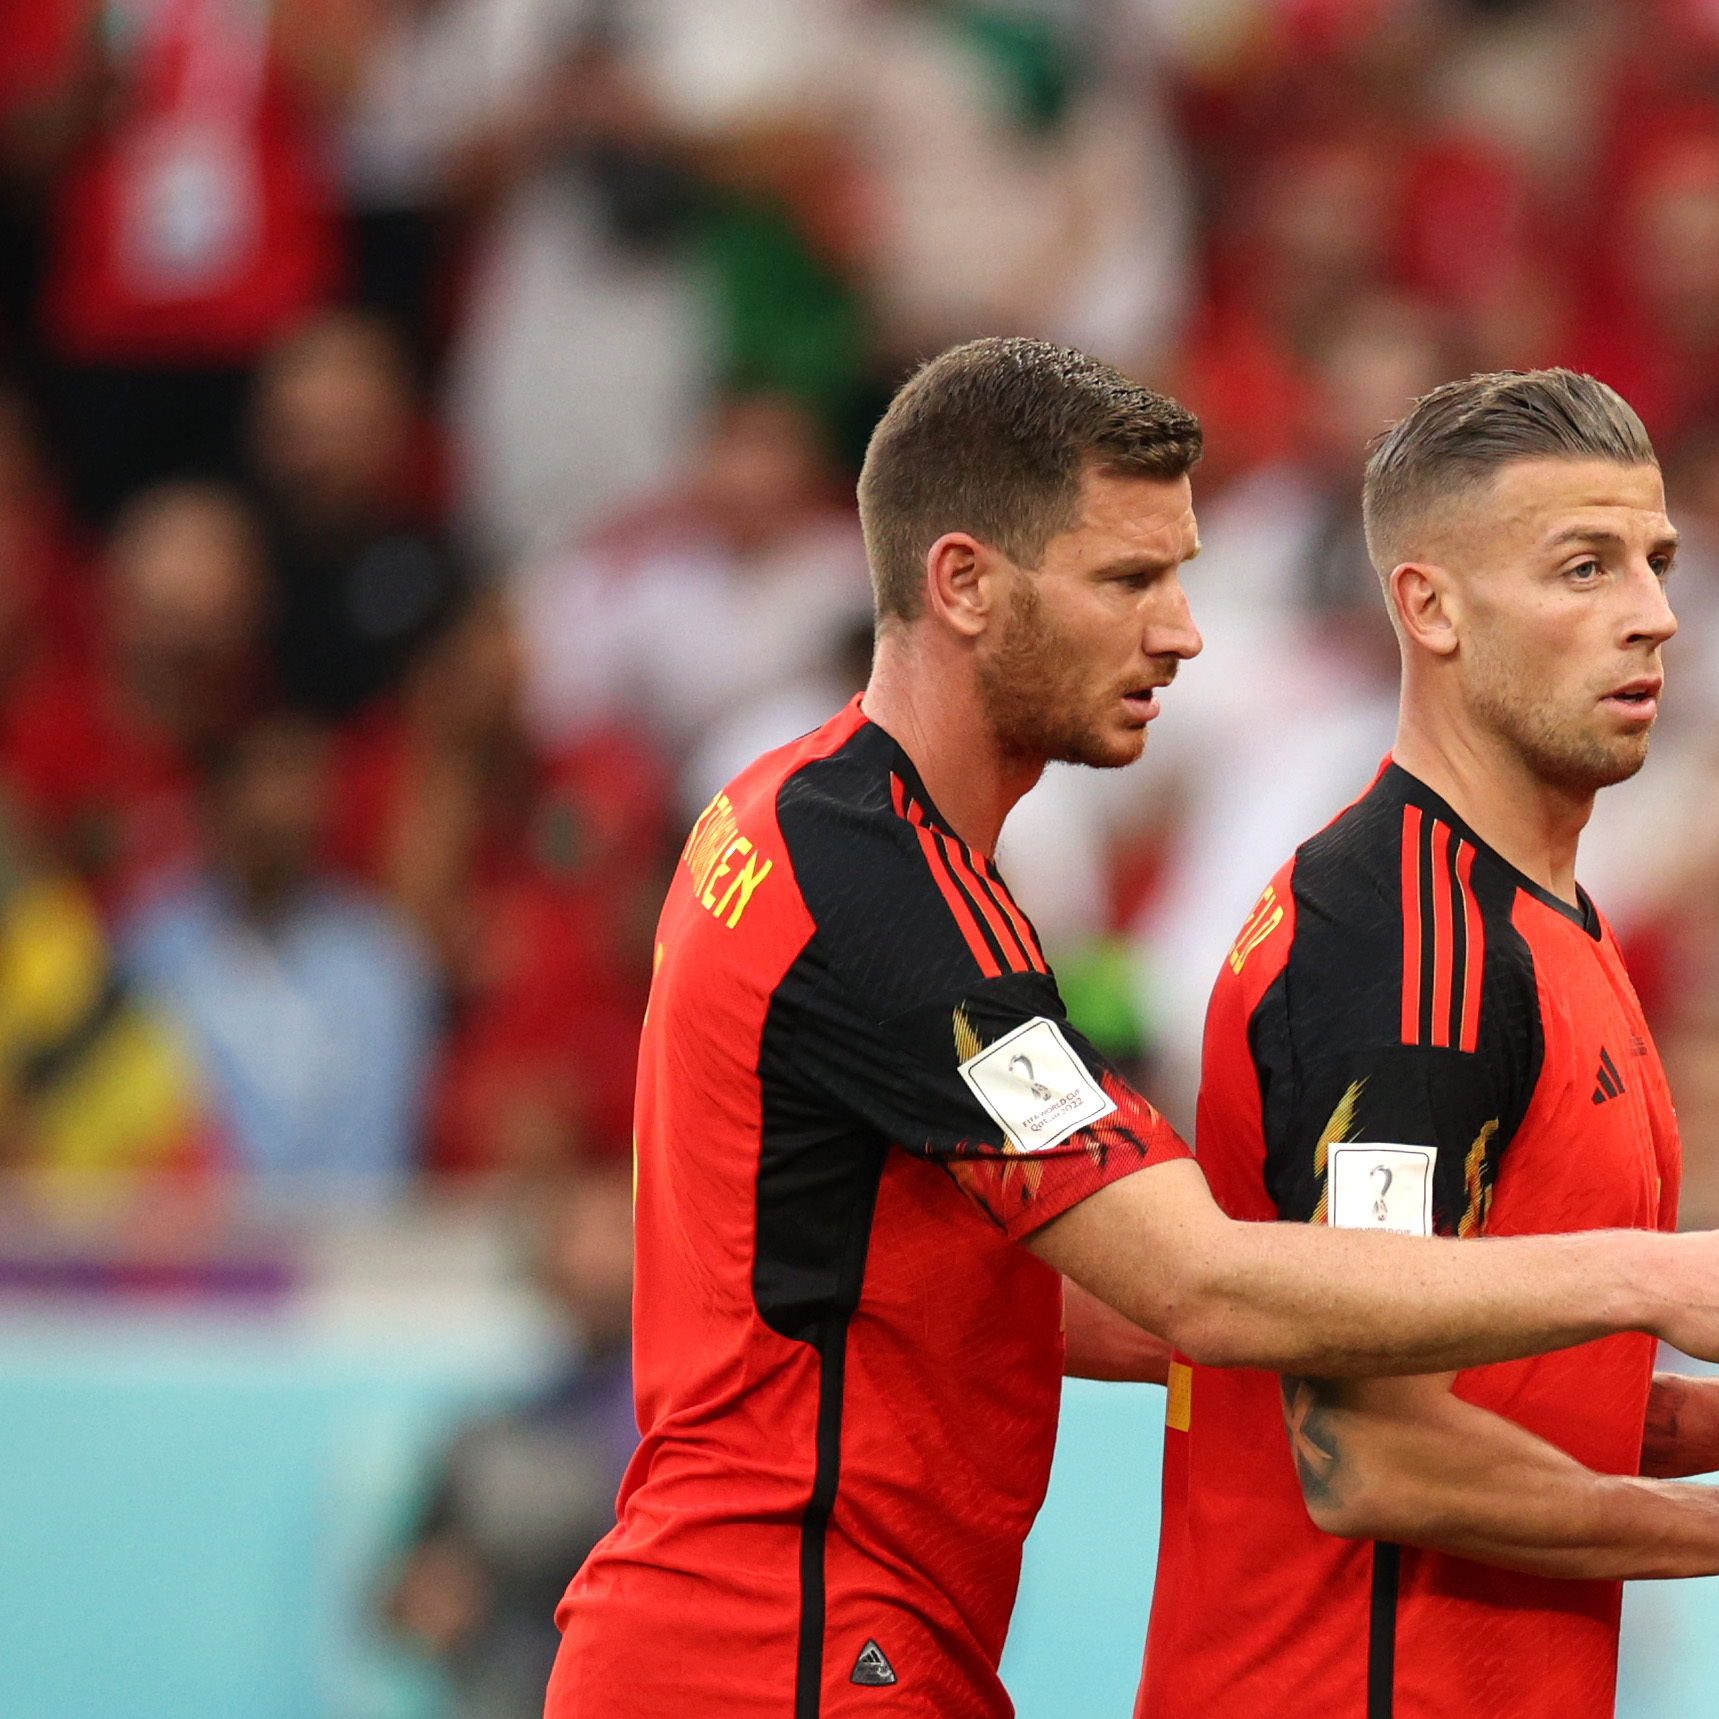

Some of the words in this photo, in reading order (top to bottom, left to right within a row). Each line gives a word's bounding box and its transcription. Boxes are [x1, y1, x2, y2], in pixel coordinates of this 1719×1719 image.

[1022, 1113, 1040, 1128] FIFA
[1039, 1097, 1067, 1118] WORLD
[1065, 1088, 1081, 1102] CUP
